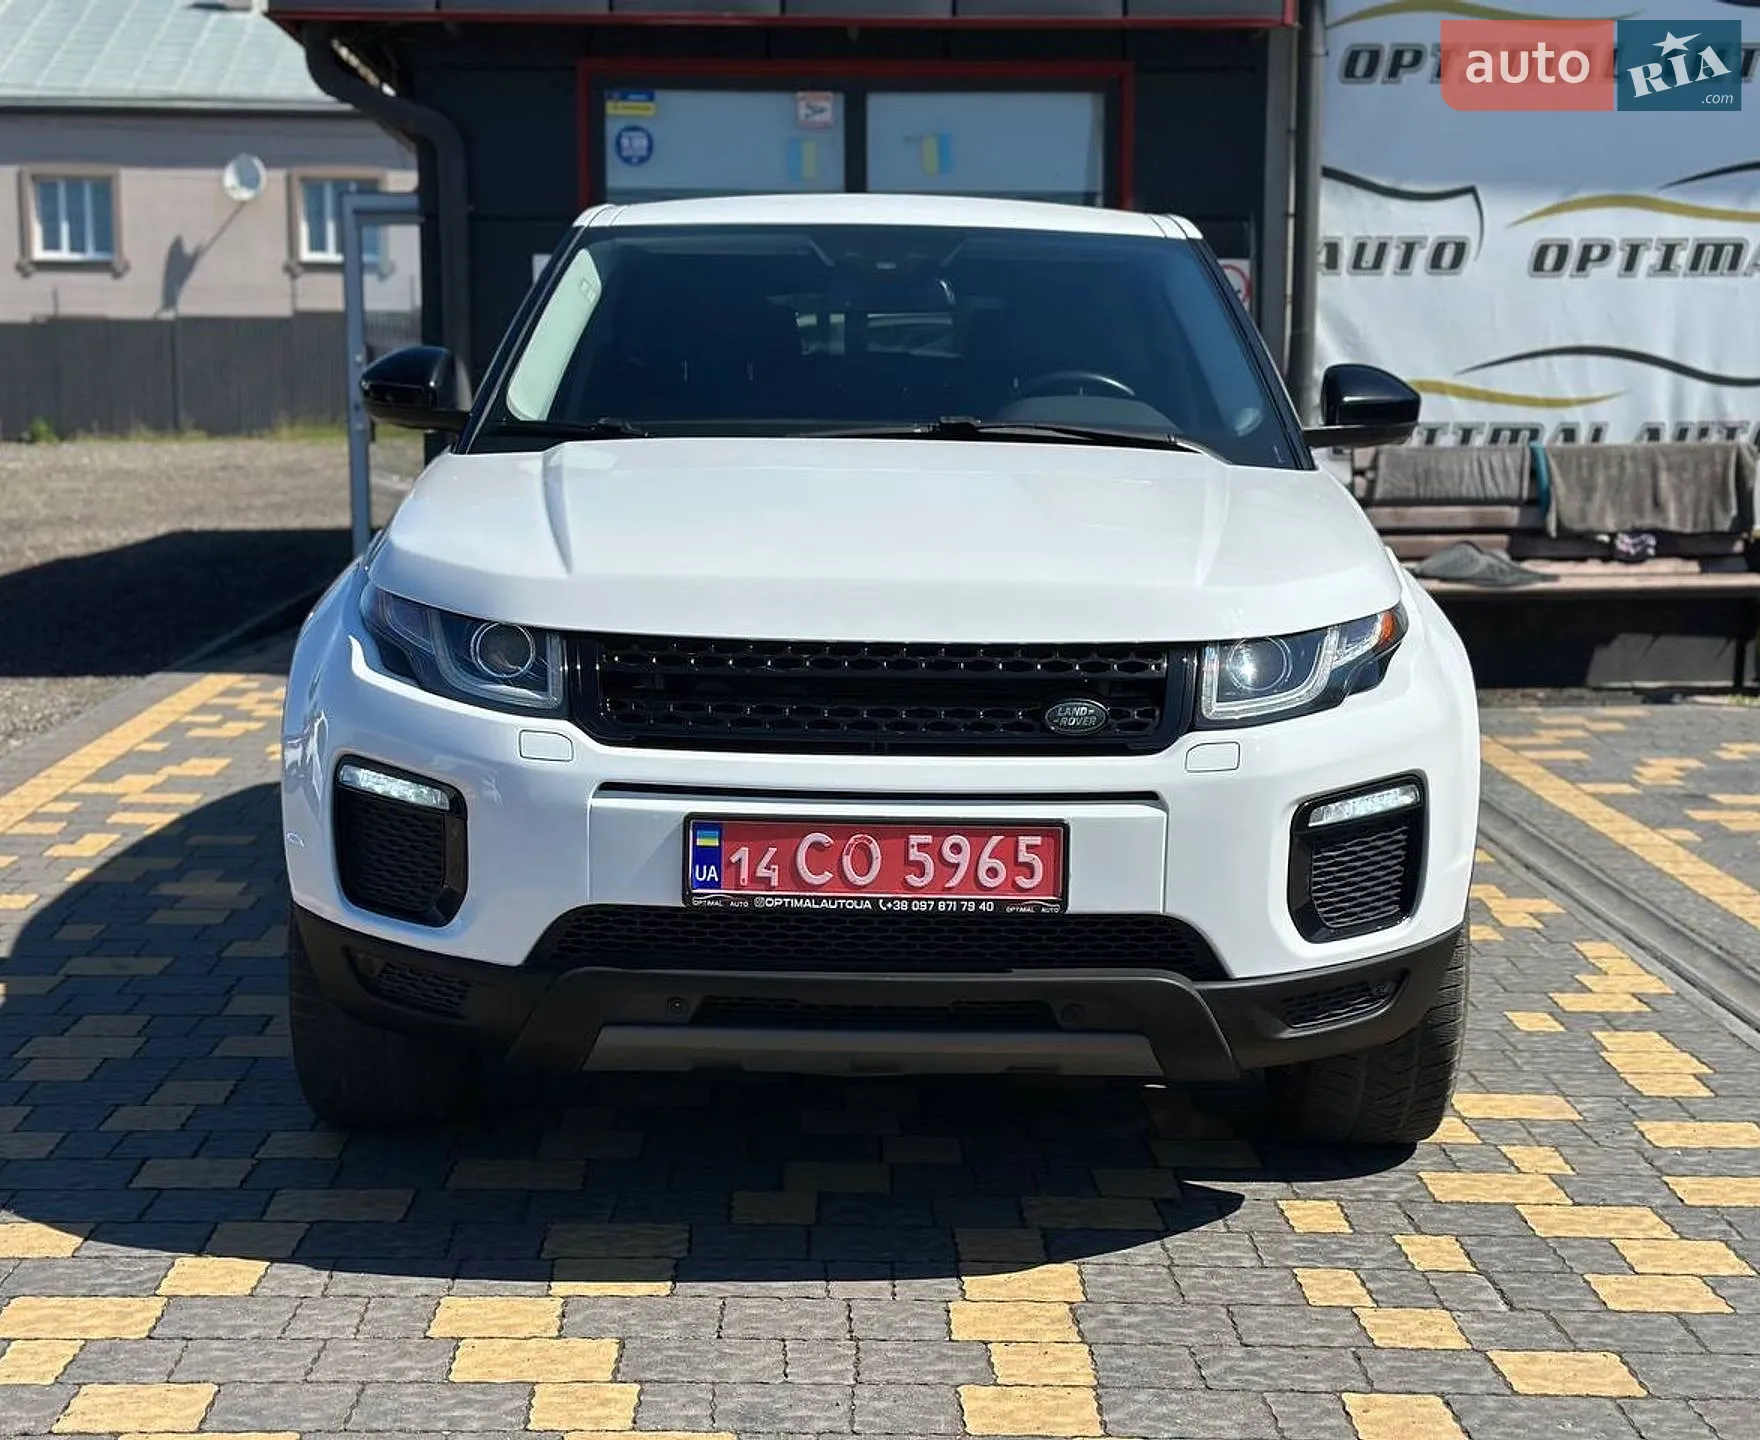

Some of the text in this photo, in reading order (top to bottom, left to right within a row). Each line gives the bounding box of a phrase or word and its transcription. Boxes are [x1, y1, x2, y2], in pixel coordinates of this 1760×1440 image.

[1528, 237, 1760, 278] OPTIM
[1057, 706, 1088, 717] LAND
[1059, 715, 1097, 726] ROVER
[729, 832, 1044, 889] 14 CO 5965
[694, 864, 719, 882] UA
[911, 901, 935, 911] 097
[938, 902, 957, 911] 871
[961, 902, 976, 912] 79
[979, 902, 994, 912] 40
